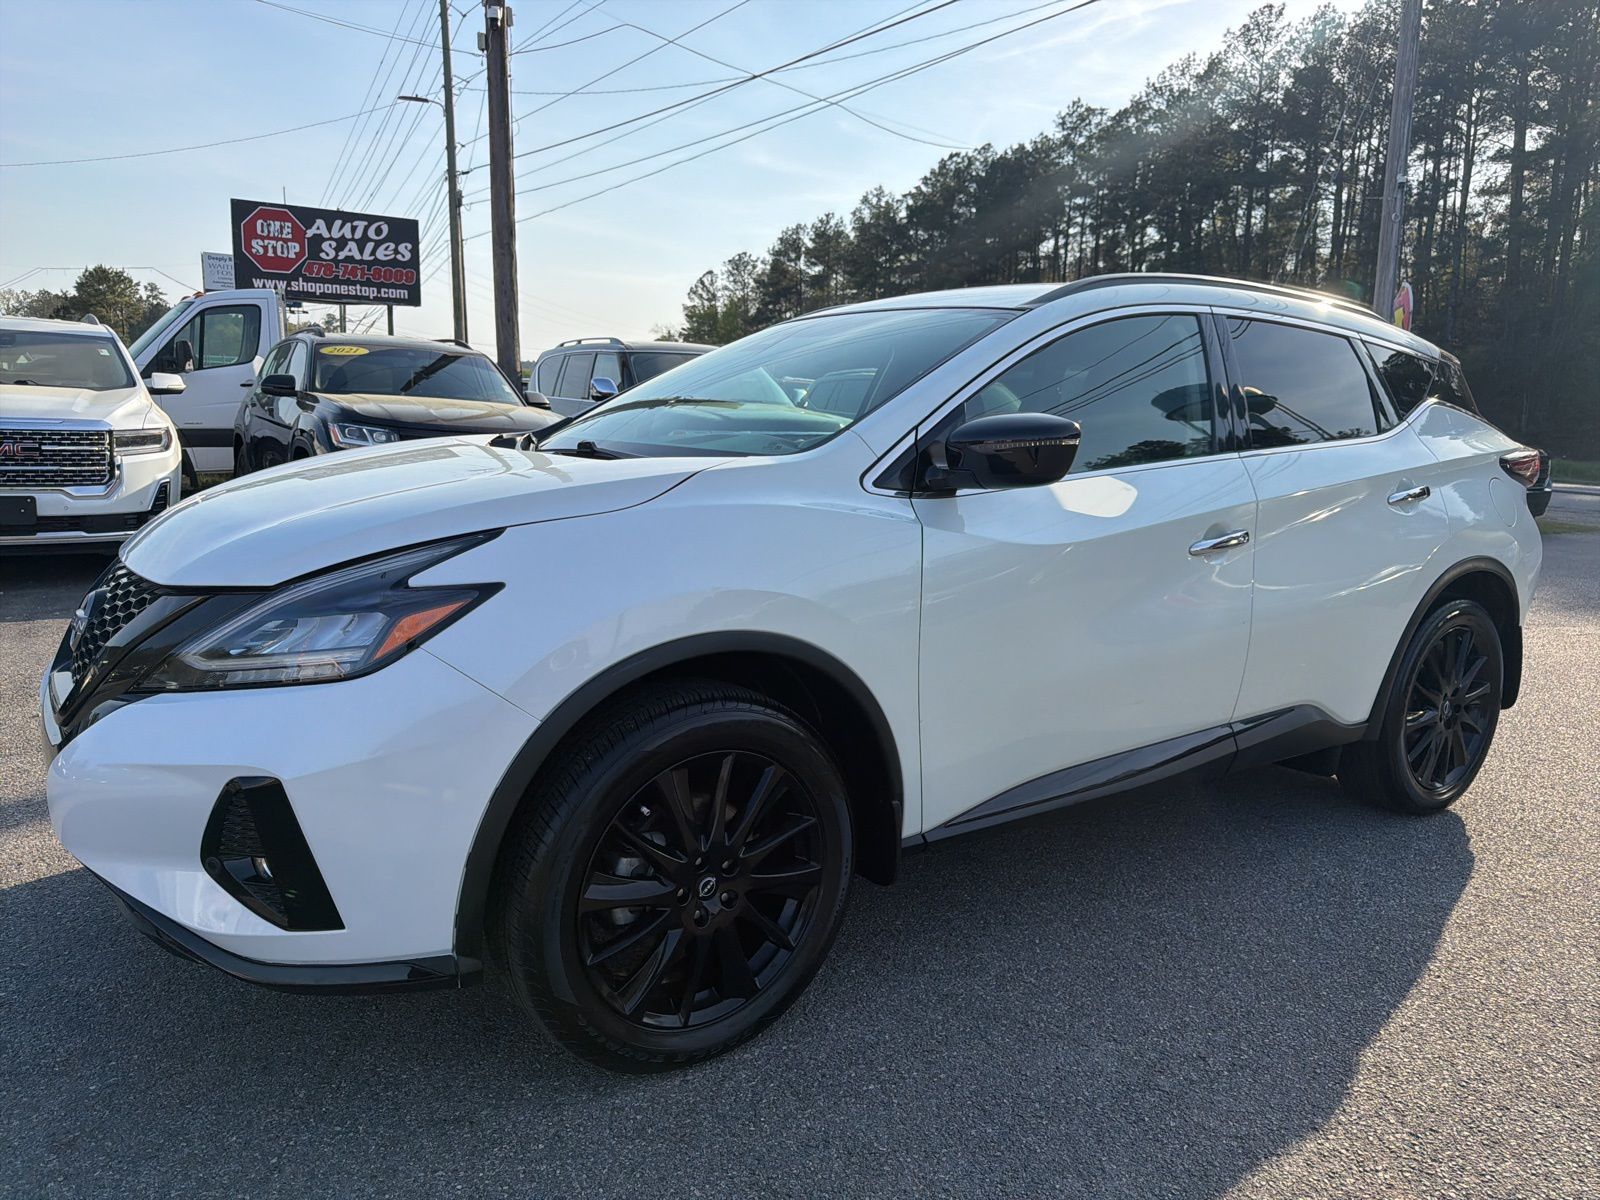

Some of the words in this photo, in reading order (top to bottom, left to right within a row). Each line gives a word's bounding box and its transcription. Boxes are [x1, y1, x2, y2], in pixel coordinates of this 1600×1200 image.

[256, 220, 292, 239] ONE
[305, 219, 389, 240] AUTO
[251, 239, 300, 259] STOP
[252, 277, 409, 300] www.shoponestop.com
